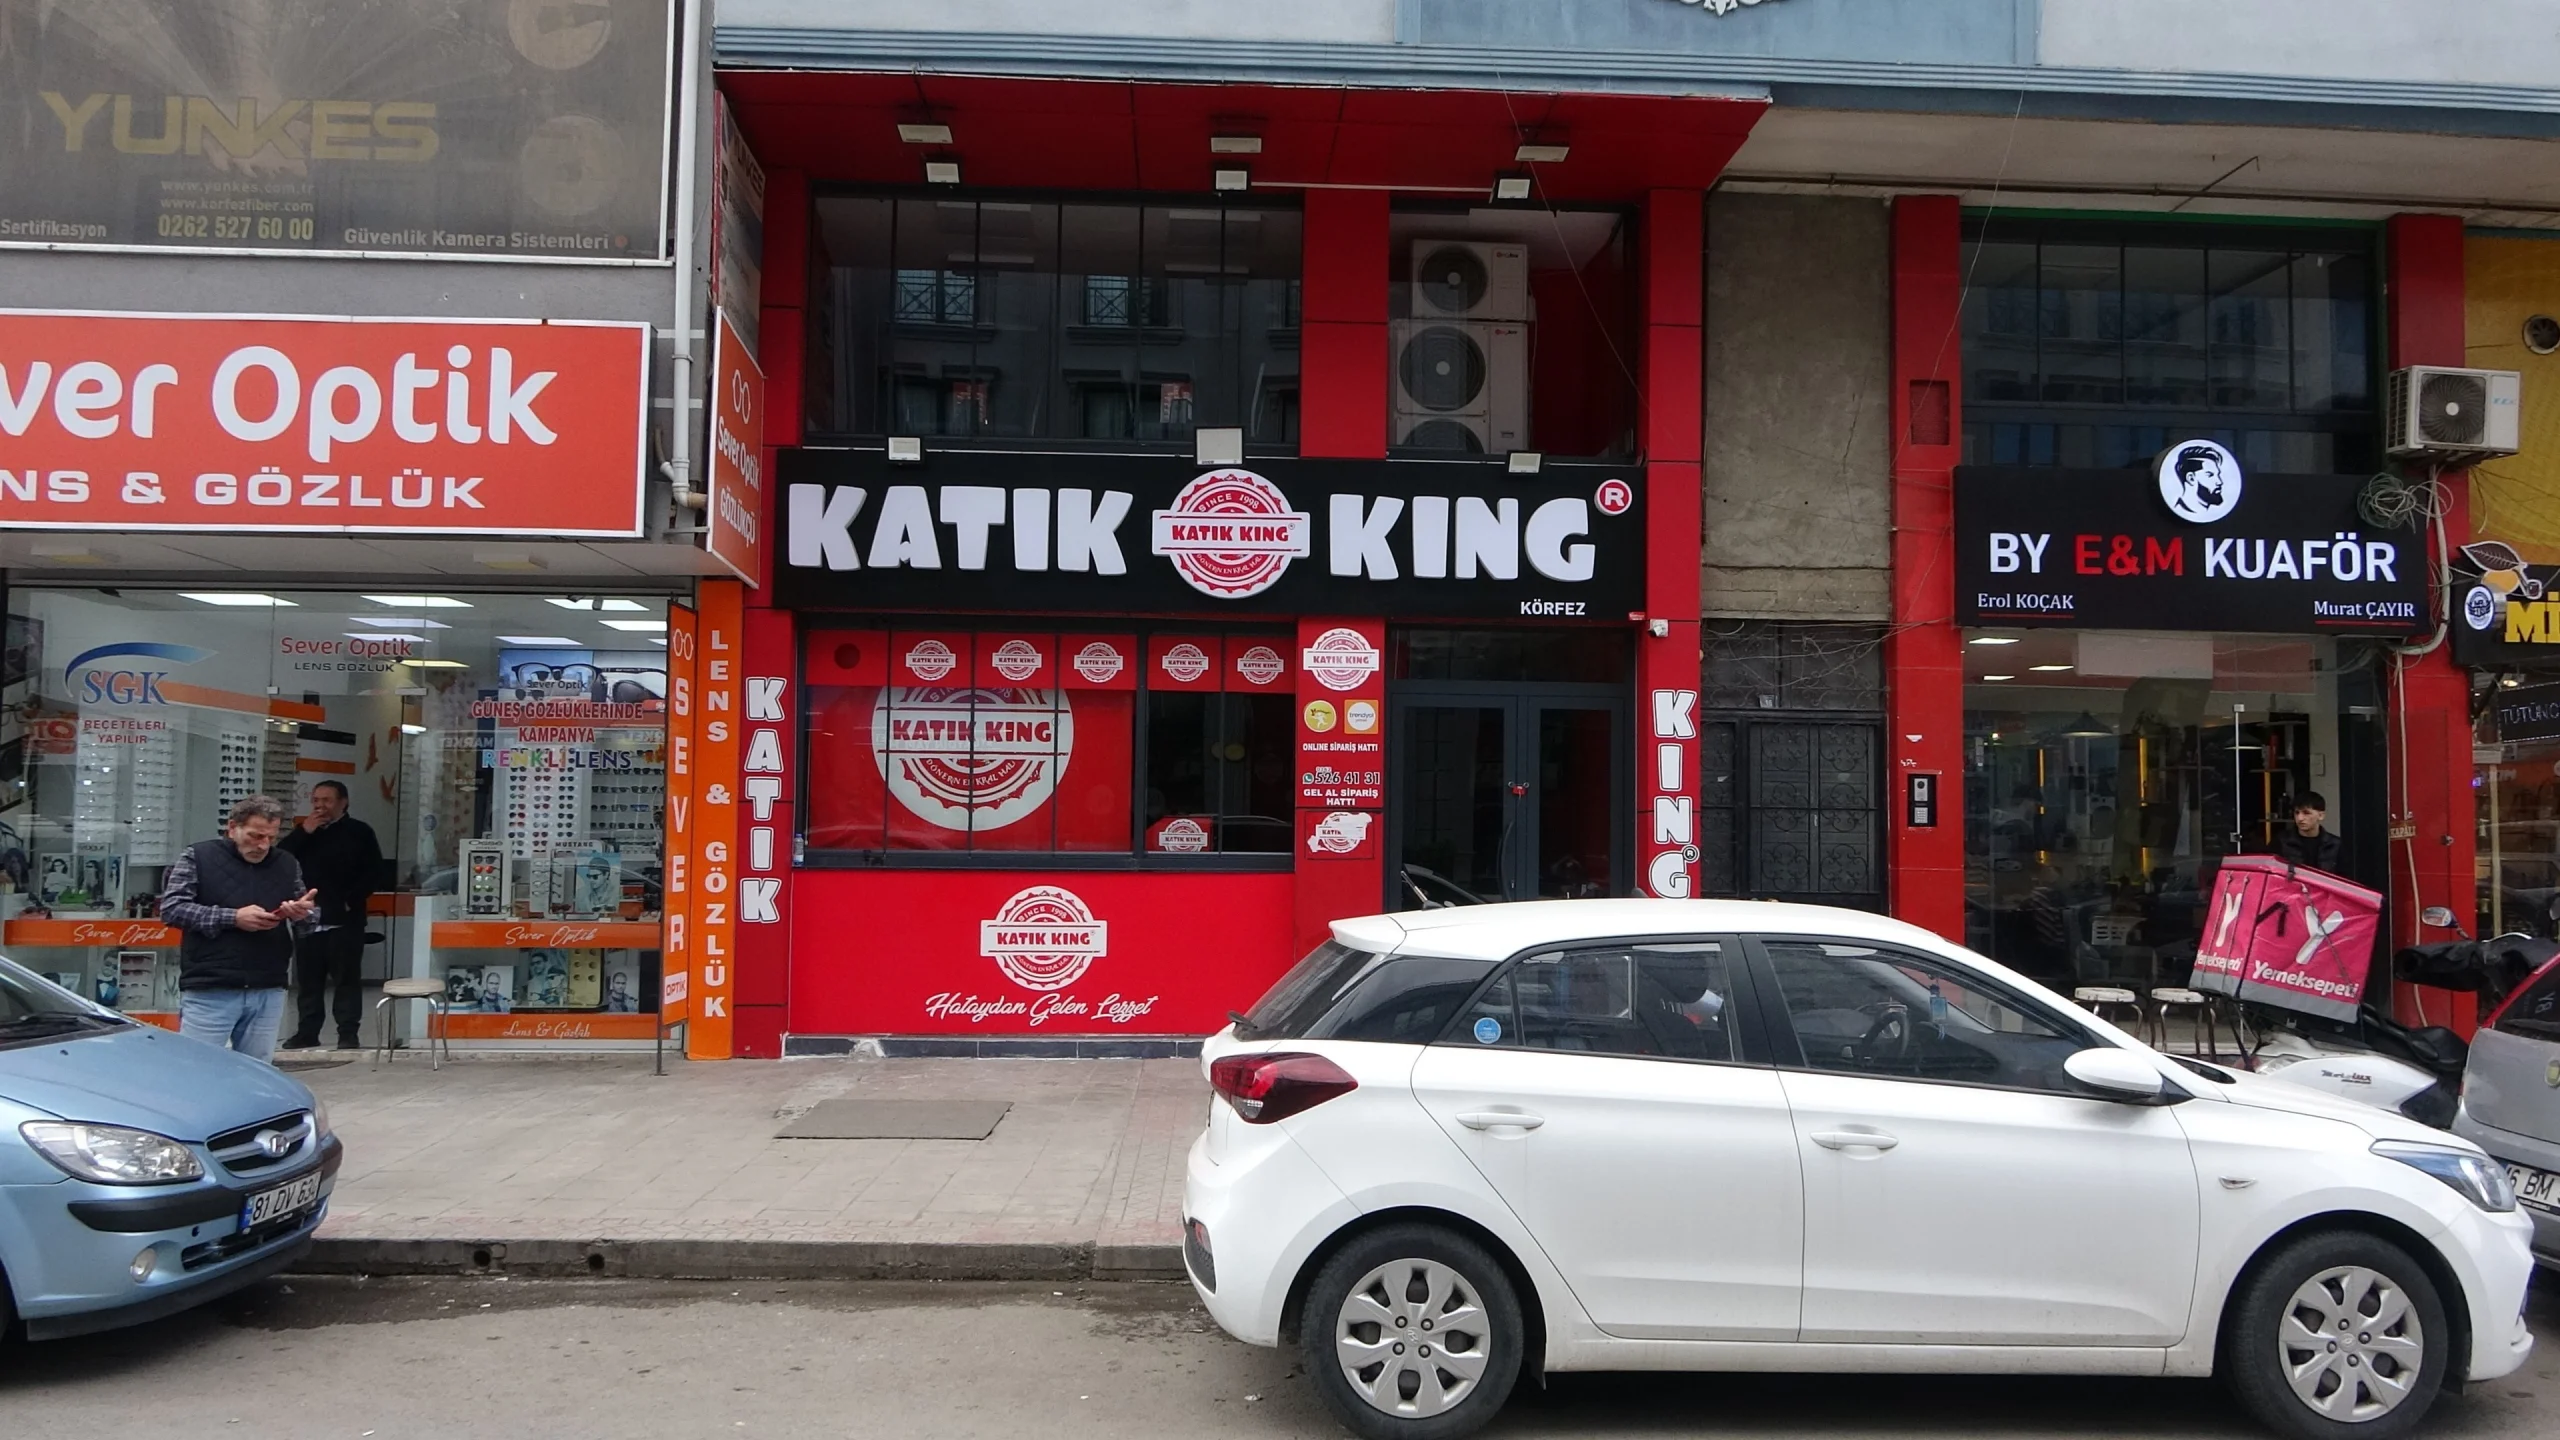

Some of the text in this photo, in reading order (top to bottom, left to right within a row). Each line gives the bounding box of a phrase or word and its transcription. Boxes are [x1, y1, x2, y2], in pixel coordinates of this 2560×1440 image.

[39, 91, 440, 164] YUNKES
[0, 217, 107, 240] Sertifikasyon
[158, 215, 314, 240] 0262 527 60 00
[344, 227, 609, 250] Güvenlik Kamera Sistemleri
[212, 344, 558, 464] Optik
[718, 415, 760, 492] Sever Optik
[121, 472, 167, 505] &
[195, 465, 486, 511] GÖZLÜK
[1198, 493, 1260, 512] SINCE 1998
[719, 485, 757, 548] GÖZLÜKÇÜ
[788, 483, 1134, 576] KATIK
[1329, 493, 1597, 582] KING
[1172, 525, 1289, 542] KATIK KING
[1990, 532, 2397, 582] BY E&M KUAFÖR
[1520, 599, 1586, 616] KÖRFEZ
[1977, 593, 2074, 613] Erol KOÇAK
[2314, 600, 2415, 621] Murat ÇAYIR
[281, 637, 413, 658] Sever Optik
[294, 662, 332, 671] LENS
[1313, 655, 1369, 665] KATIK KING
[82, 670, 170, 707] SGK
[526, 679, 588, 691] Sever Optik
[472, 696, 521, 723] GÜNEŞ
[98, 734, 148, 744] YAPILIR
[518, 727, 596, 743] KAMPANYA
[893, 720, 1052, 742] KATIK KING
[482, 746, 632, 769] RENKLİ LENS
[1302, 741, 1379, 754] ONLINE SİPARİŞ HATTI
[975, 774, 999, 786] KRAL
[1314, 771, 1381, 785] 526 41 31
[739, 676, 787, 923] KATIK
[1303, 787, 1379, 799] GEL AL SİPARİŞ
[1326, 798, 1356, 806] HATTI
[1649, 690, 1697, 899] KING
[670, 677, 690, 953] SEVER
[704, 629, 731, 1018] LENS & GÖZLÜK
[1018, 906, 1068, 923] SINCE 1998
[73, 924, 170, 945] Sever Optik
[504, 925, 598, 947] Sever Optik
[997, 932, 1091, 946] KATIK KING
[665, 979, 687, 997] OPTİK
[2252, 959, 2360, 998] Yemeksepeti
[925, 992, 1027, 1023] Hataydan
[1029, 993, 1089, 1026] Gelen
[502, 1020, 591, 1039] Lens & Gözlük
[2523, 1172, 2555, 1201] BM
[253, 1194, 271, 1221] 81
[273, 1184, 297, 1214] DV
